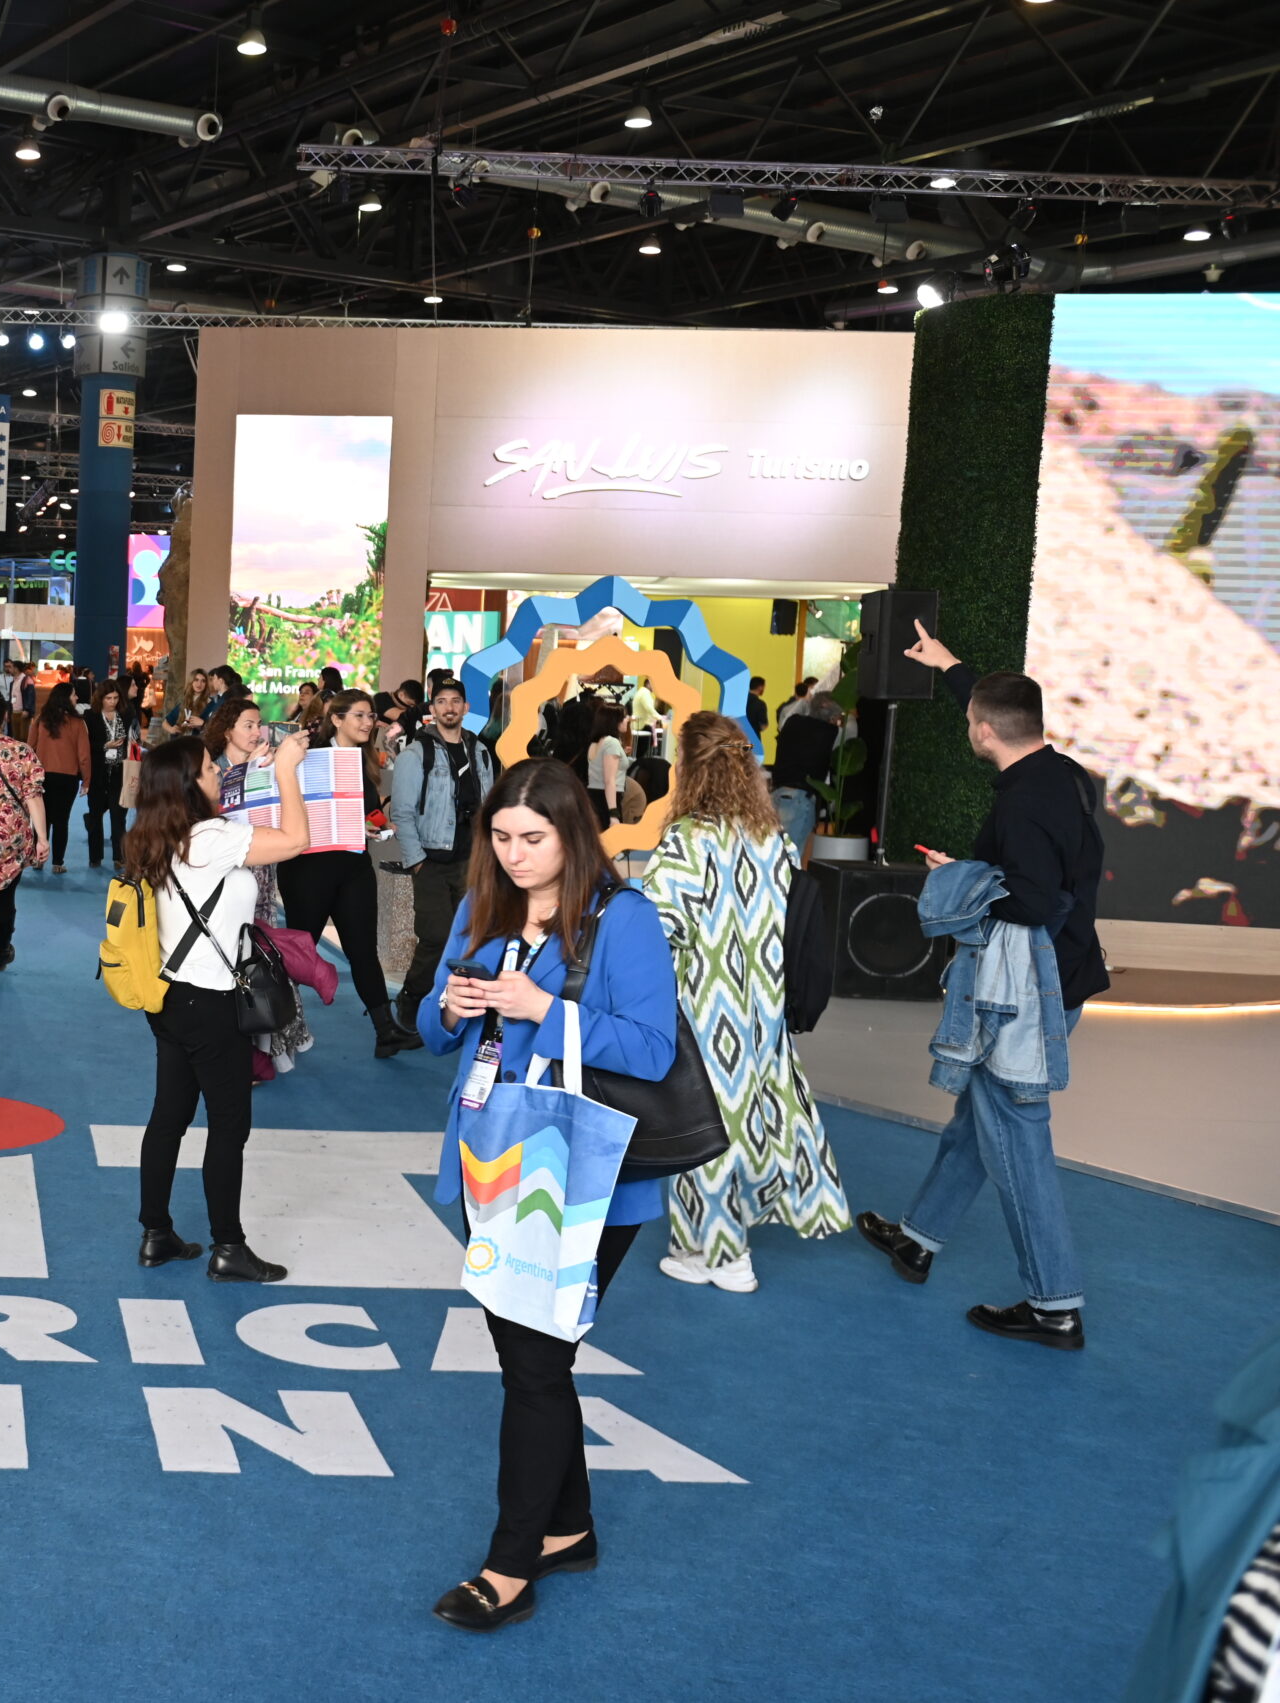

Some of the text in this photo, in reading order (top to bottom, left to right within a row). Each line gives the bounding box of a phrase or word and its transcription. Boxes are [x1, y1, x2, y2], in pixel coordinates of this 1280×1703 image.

[747, 448, 871, 482] Turismo
[257, 665, 282, 677] San
[248, 682, 300, 694] del Mon
[504, 1252, 554, 1281] Argentina
